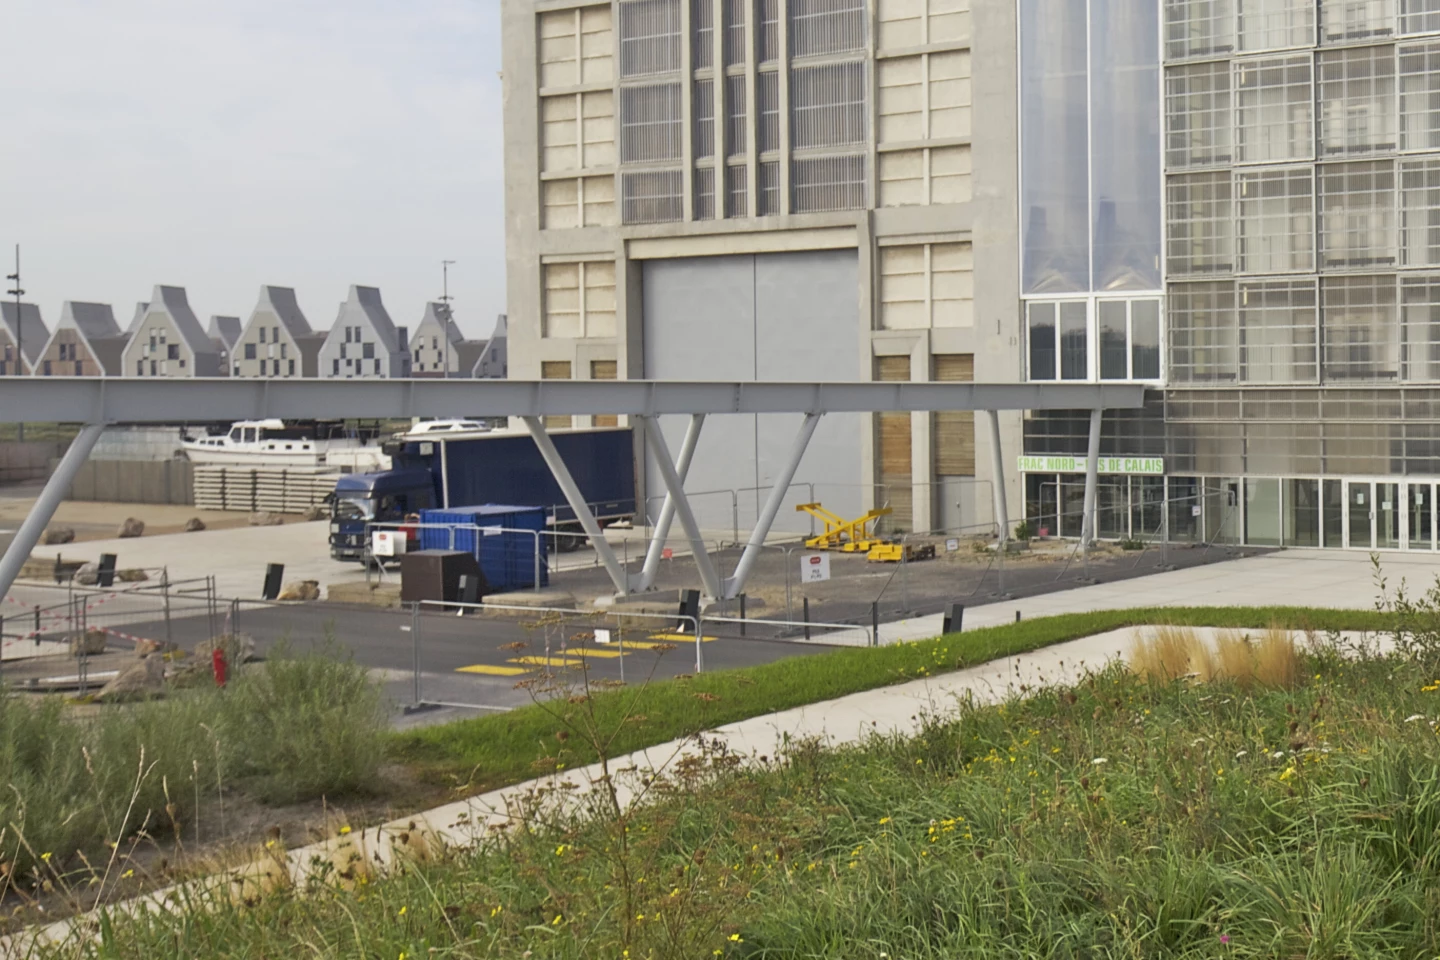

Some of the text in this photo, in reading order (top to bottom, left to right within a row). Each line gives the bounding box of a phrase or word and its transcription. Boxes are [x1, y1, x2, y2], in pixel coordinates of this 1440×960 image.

[1018, 457, 1043, 470] FRAC
[1109, 459, 1121, 472] DE
[1124, 459, 1163, 472] CALAIS
